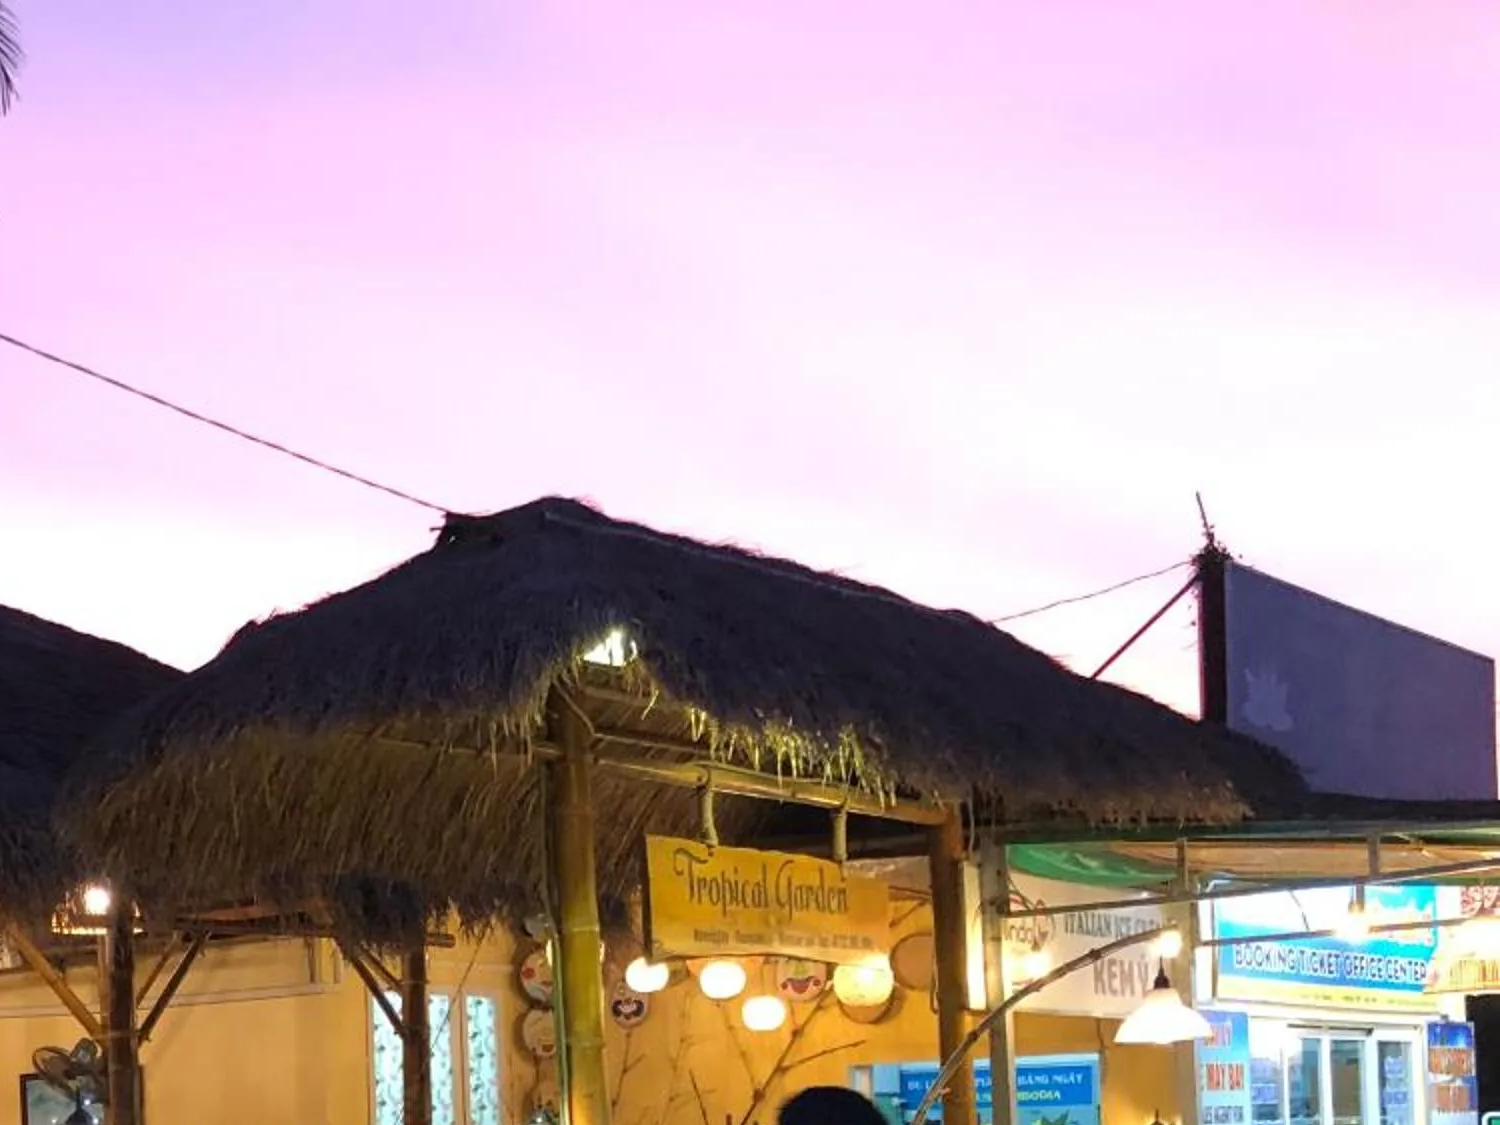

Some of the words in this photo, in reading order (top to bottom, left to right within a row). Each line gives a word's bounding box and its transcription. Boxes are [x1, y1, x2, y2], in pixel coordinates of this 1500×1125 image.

[673, 848, 770, 917] Tropical
[776, 860, 848, 920] Garden
[1064, 912, 1112, 936] ITALIAN
[1235, 944, 1295, 970] BOOKING
[1299, 949, 1339, 975] TICKET
[1345, 953, 1383, 979] OFFICE
[1386, 957, 1427, 981] CENTER
